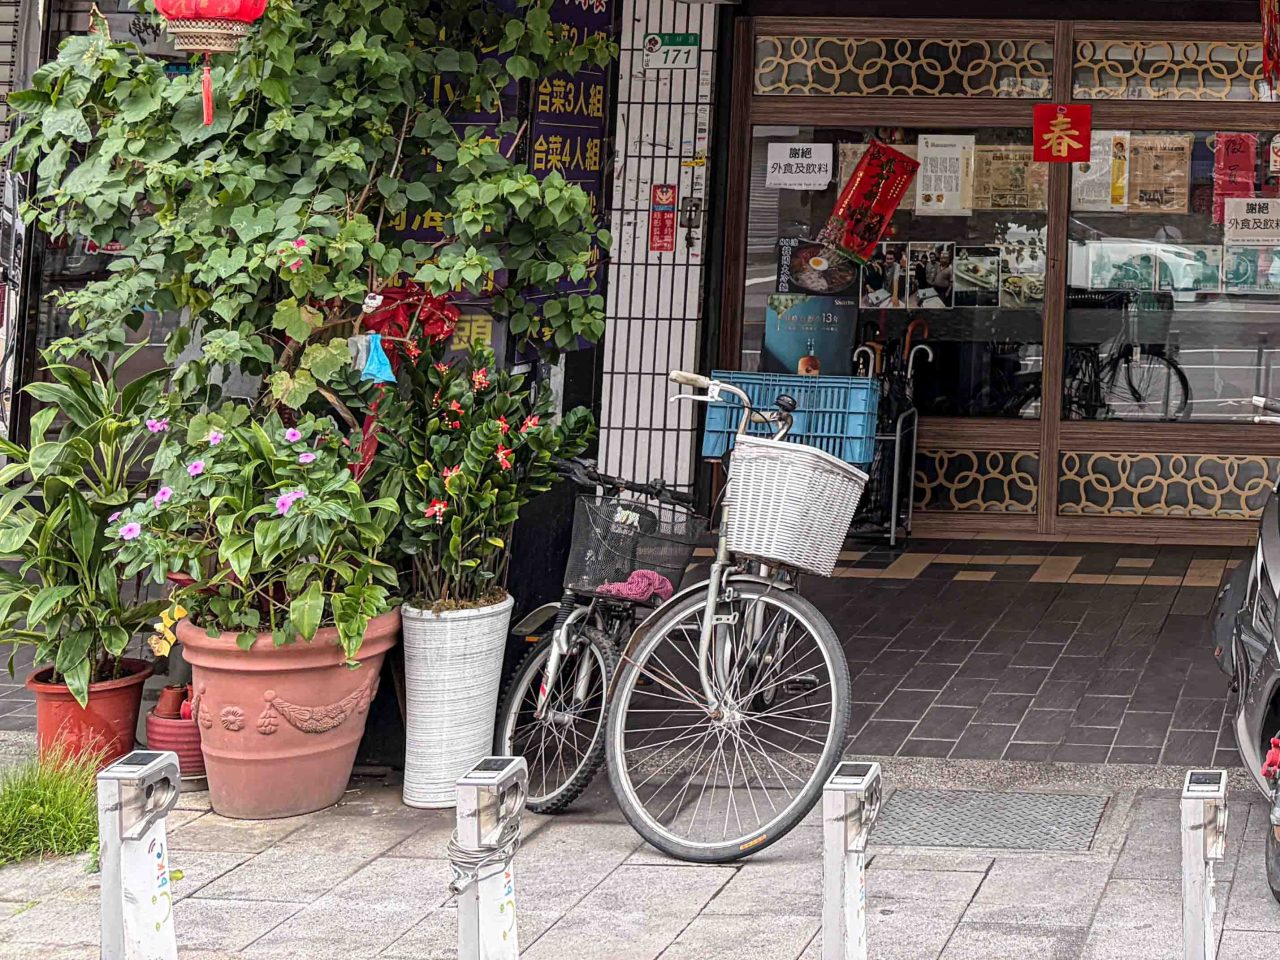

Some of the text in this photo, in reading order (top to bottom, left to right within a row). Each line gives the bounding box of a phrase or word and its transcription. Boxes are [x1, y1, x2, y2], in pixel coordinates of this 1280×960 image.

[662, 49, 692, 65] 171
[538, 79, 604, 118] 合菜3人組
[1042, 112, 1083, 158] 春
[533, 134, 601, 172] 合菜4人組
[788, 147, 812, 159] 謝絕
[771, 162, 828, 175] 外食及飲料
[1246, 202, 1269, 215] 謝絕
